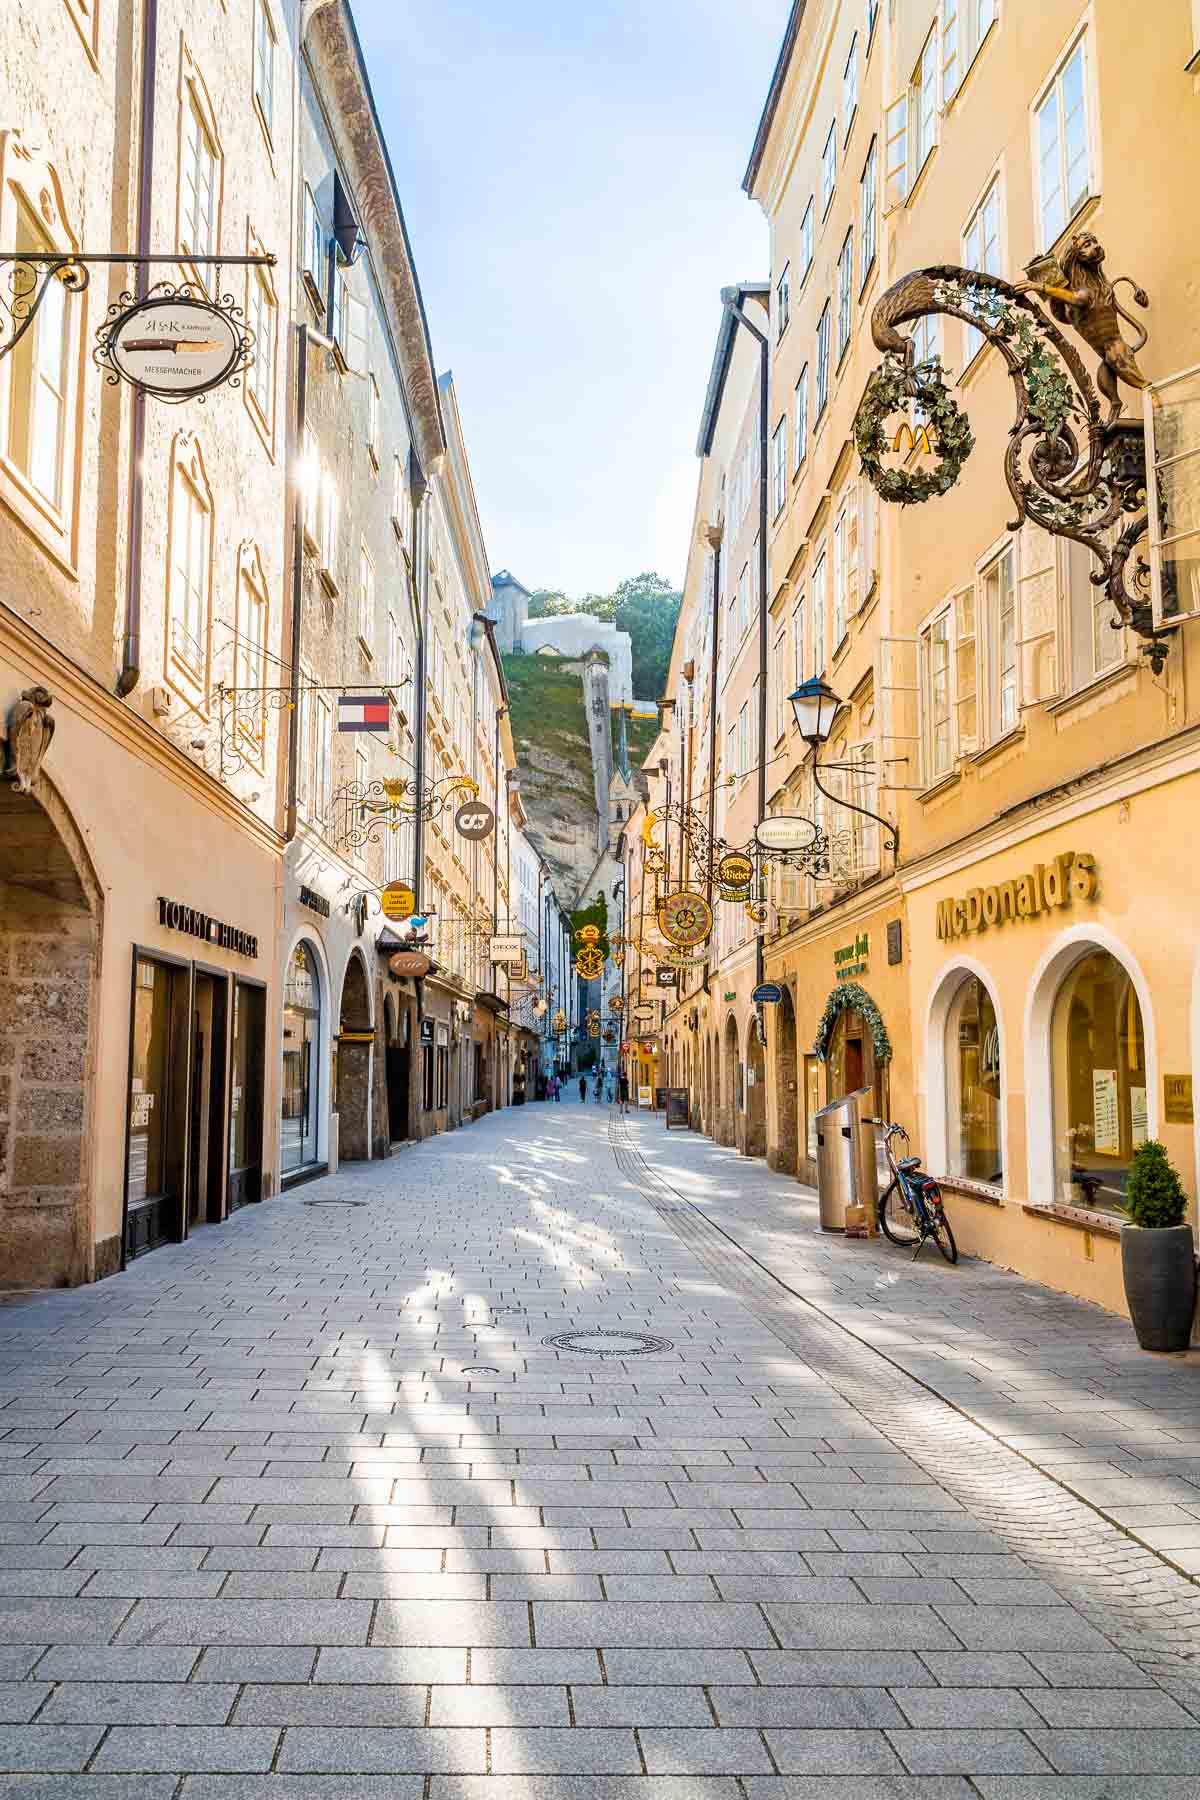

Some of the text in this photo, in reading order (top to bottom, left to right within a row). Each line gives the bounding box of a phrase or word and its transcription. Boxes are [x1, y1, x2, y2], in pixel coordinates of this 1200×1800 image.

[144, 366, 202, 376] MESSERMACHER
[936, 850, 1097, 940] McDonald's
[157, 896, 258, 959] TOMMY HILFIGER
[492, 943, 519, 951] GEOX
